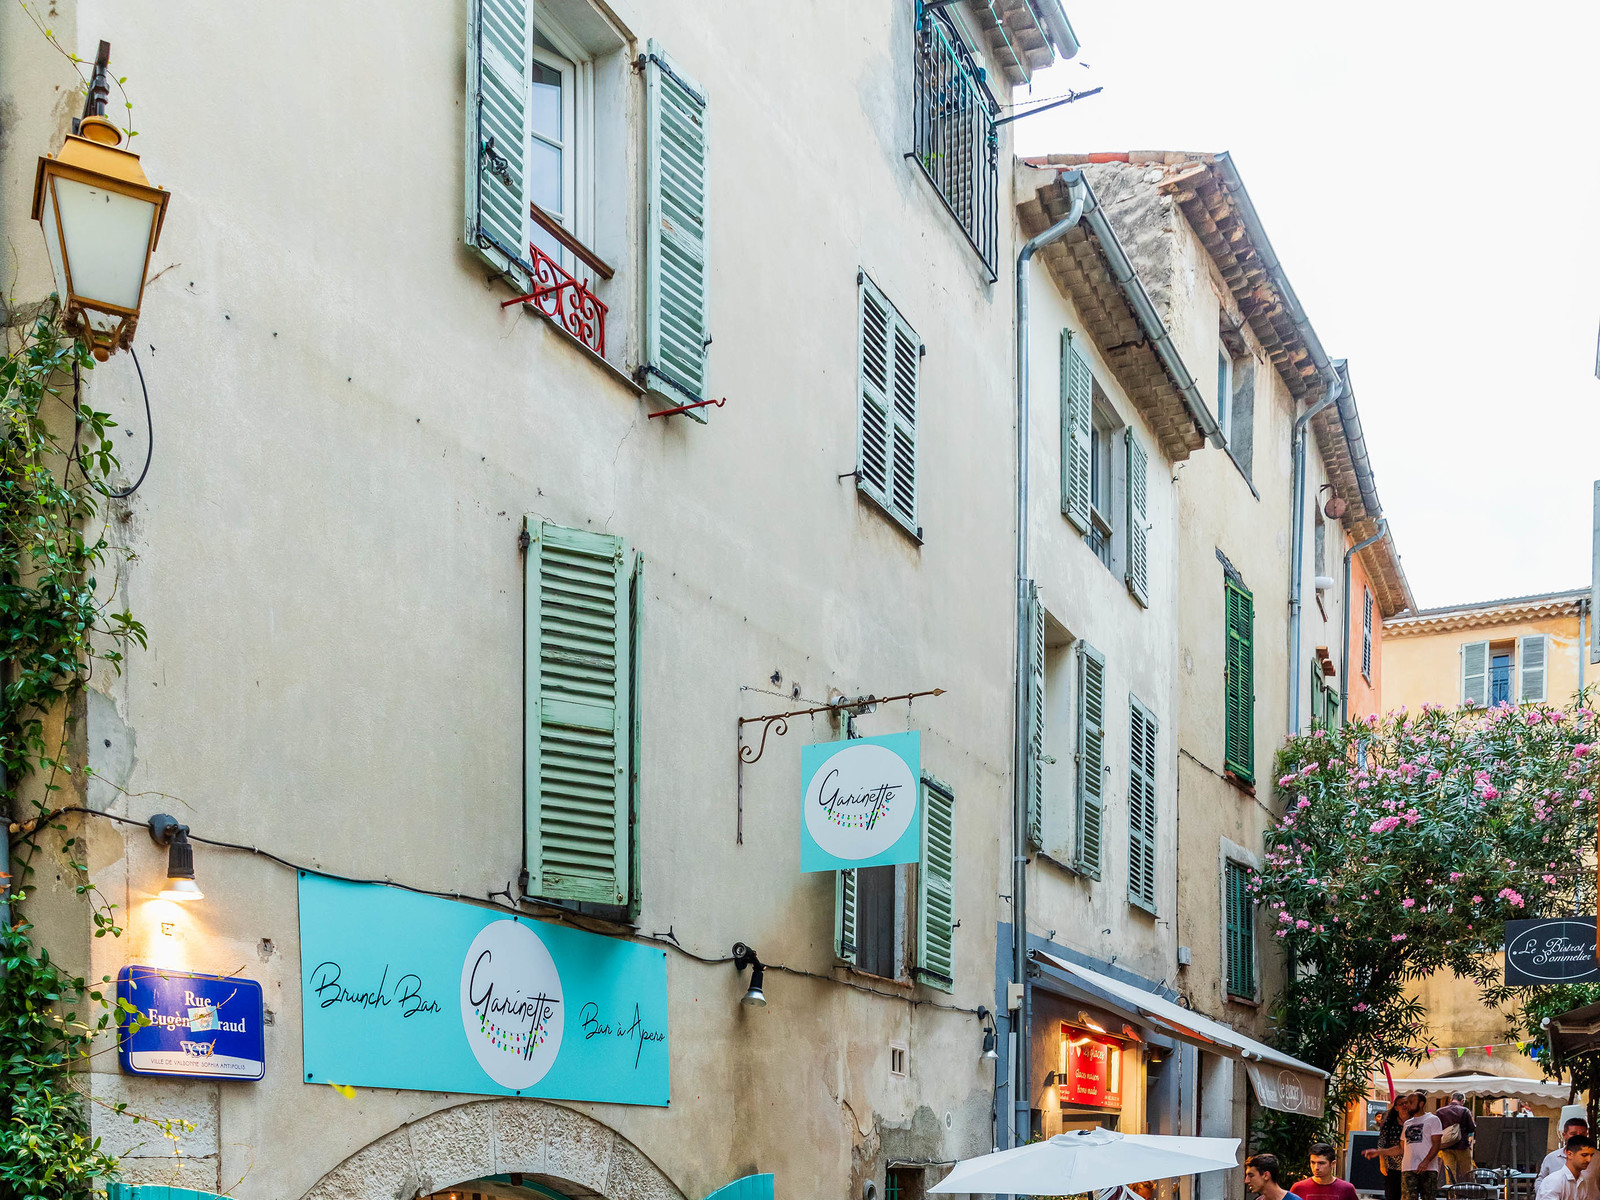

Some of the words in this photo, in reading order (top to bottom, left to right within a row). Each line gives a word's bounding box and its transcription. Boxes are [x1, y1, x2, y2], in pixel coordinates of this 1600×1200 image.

[819, 769, 902, 830] Garinette
[1518, 939, 1537, 954] Le
[1533, 949, 1592, 965] Sommelier
[185, 990, 212, 1007] Rue
[310, 961, 391, 1009] Brunch
[394, 974, 441, 1018] Bar
[148, 1008, 190, 1031] Eugèn
[218, 1018, 246, 1033] raud
[470, 950, 560, 1061] Garinette
[579, 1002, 612, 1040] Bar
